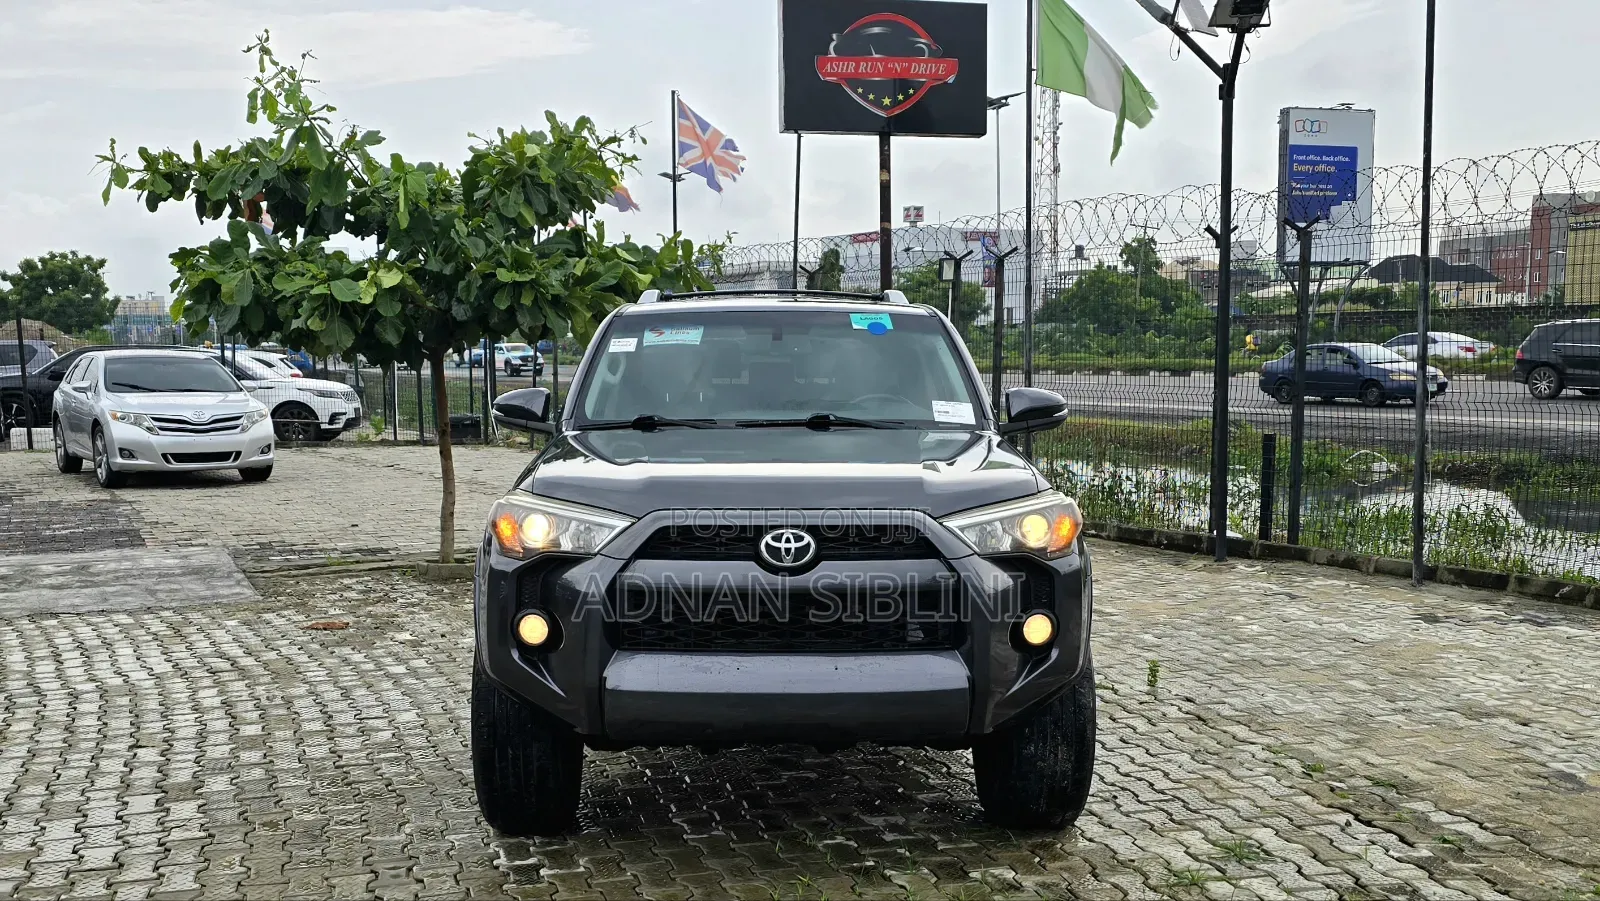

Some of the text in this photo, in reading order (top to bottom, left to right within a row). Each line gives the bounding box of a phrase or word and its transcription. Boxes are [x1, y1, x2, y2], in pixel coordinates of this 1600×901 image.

[823, 61, 856, 74] ASHR
[858, 61, 885, 74] RUN
[910, 62, 948, 75] DRIVE
[1293, 163, 1338, 174] Every office.
